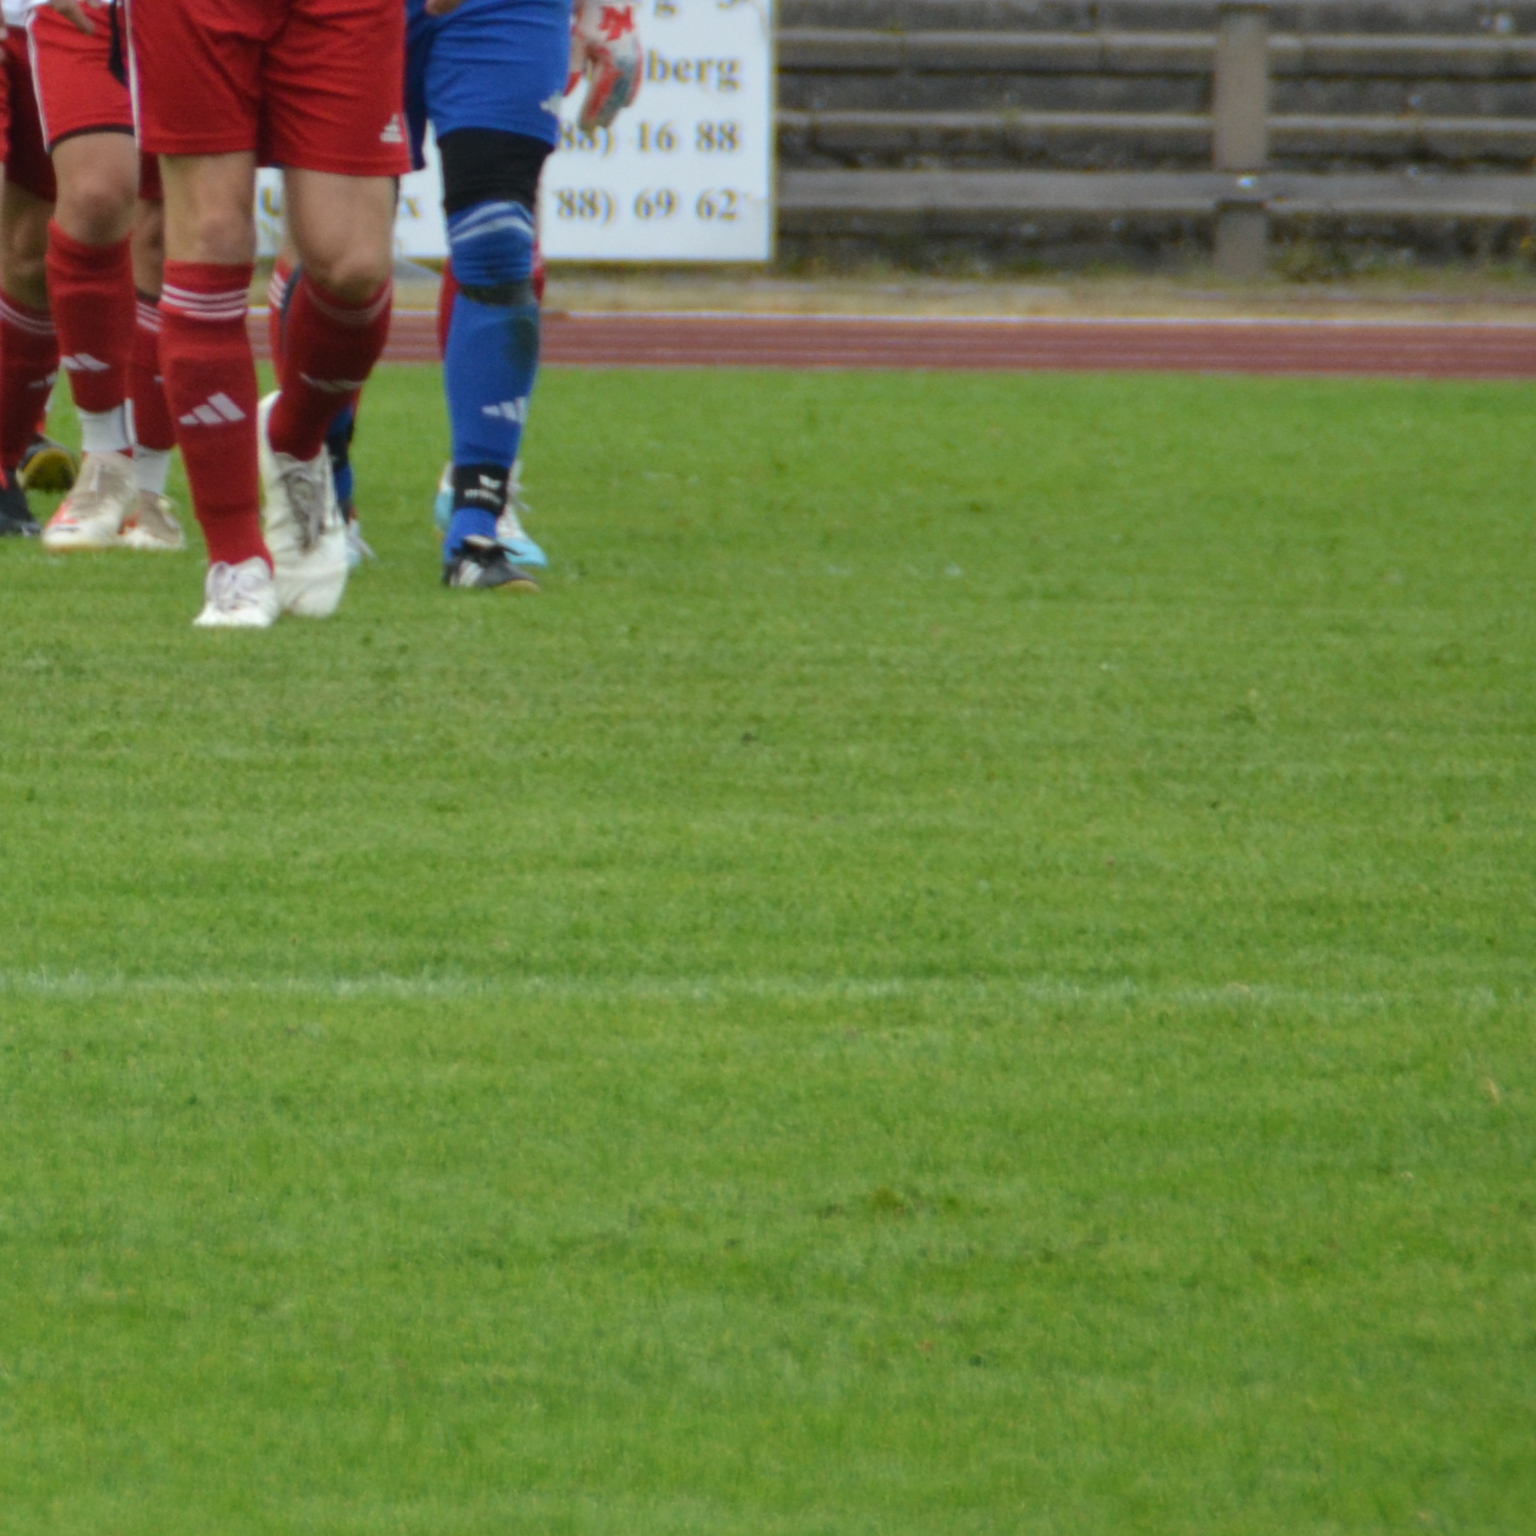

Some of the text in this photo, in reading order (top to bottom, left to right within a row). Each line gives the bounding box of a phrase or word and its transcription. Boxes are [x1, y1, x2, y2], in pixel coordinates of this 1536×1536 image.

[638, 120, 678, 152] 16
[697, 120, 741, 152] 88
[635, 189, 678, 220] 69
[697, 189, 739, 220] 62
